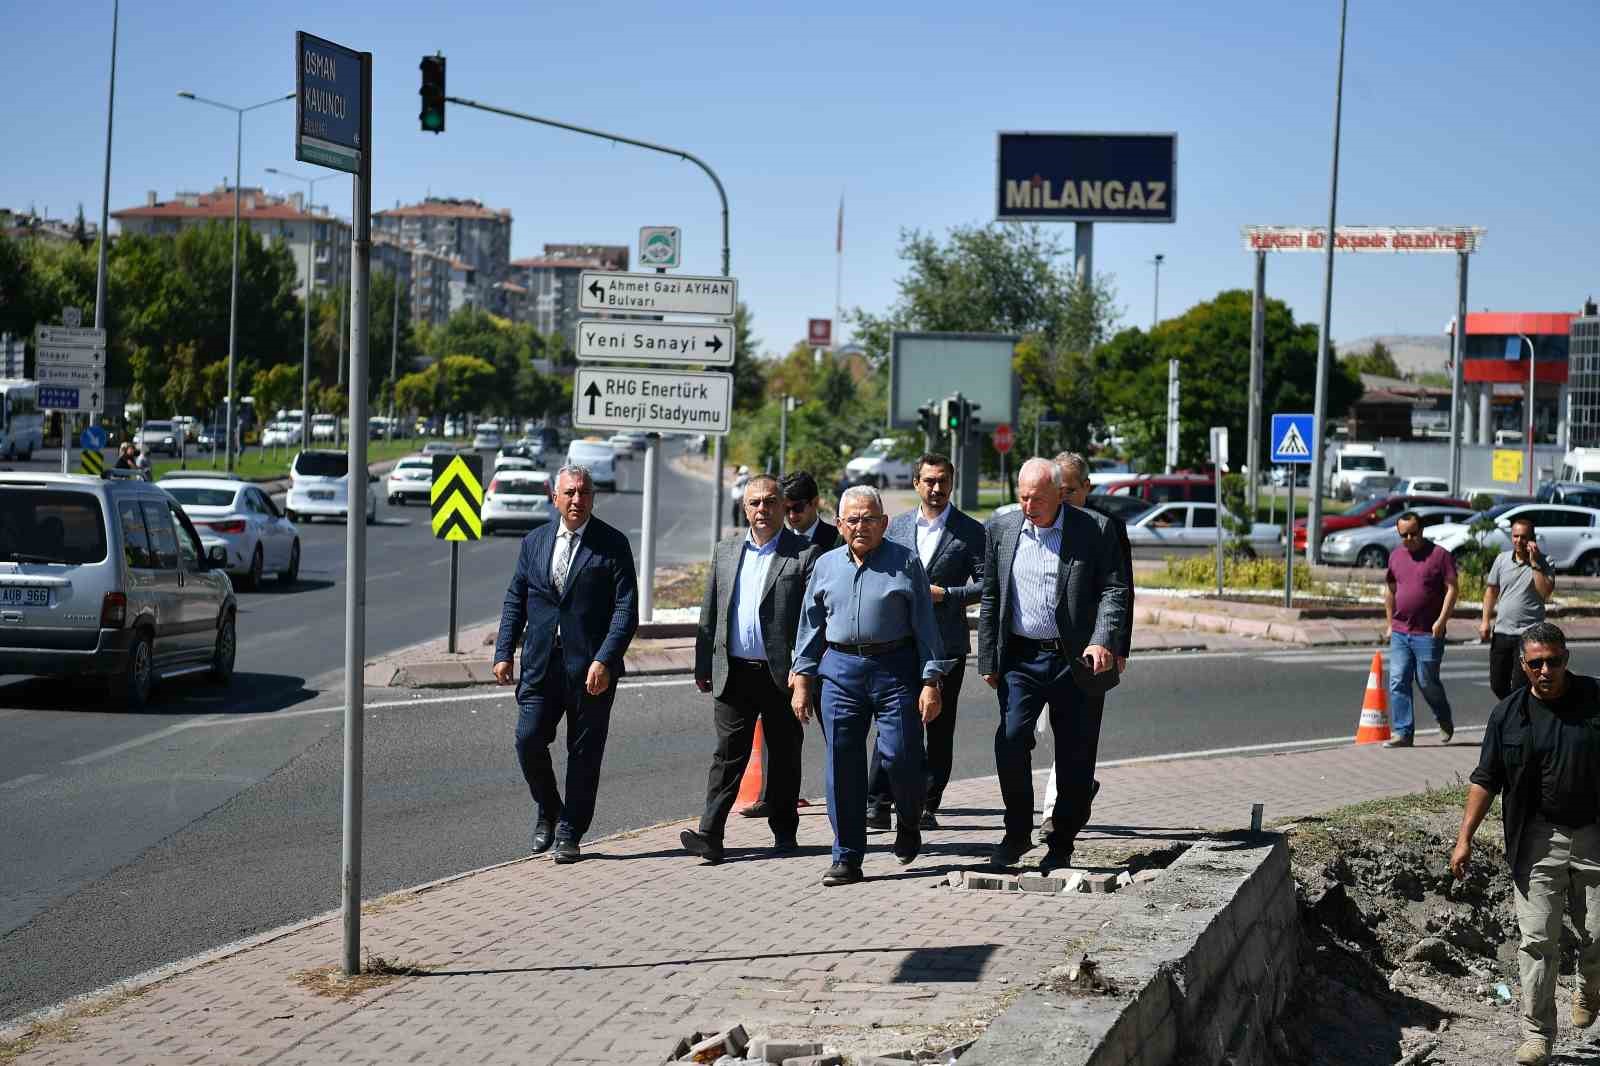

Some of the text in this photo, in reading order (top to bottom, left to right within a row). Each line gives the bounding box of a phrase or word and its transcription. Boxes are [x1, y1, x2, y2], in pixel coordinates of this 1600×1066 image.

[305, 50, 336, 81] OSMAN
[305, 87, 346, 121] KAVUNCU
[609, 279, 729, 295] Ahmet Gazi AYHAN
[586, 331, 696, 353] Yeni Sanayi
[606, 379, 708, 399] RHG Enertürk
[605, 402, 720, 424] Enerji Stadyumu
